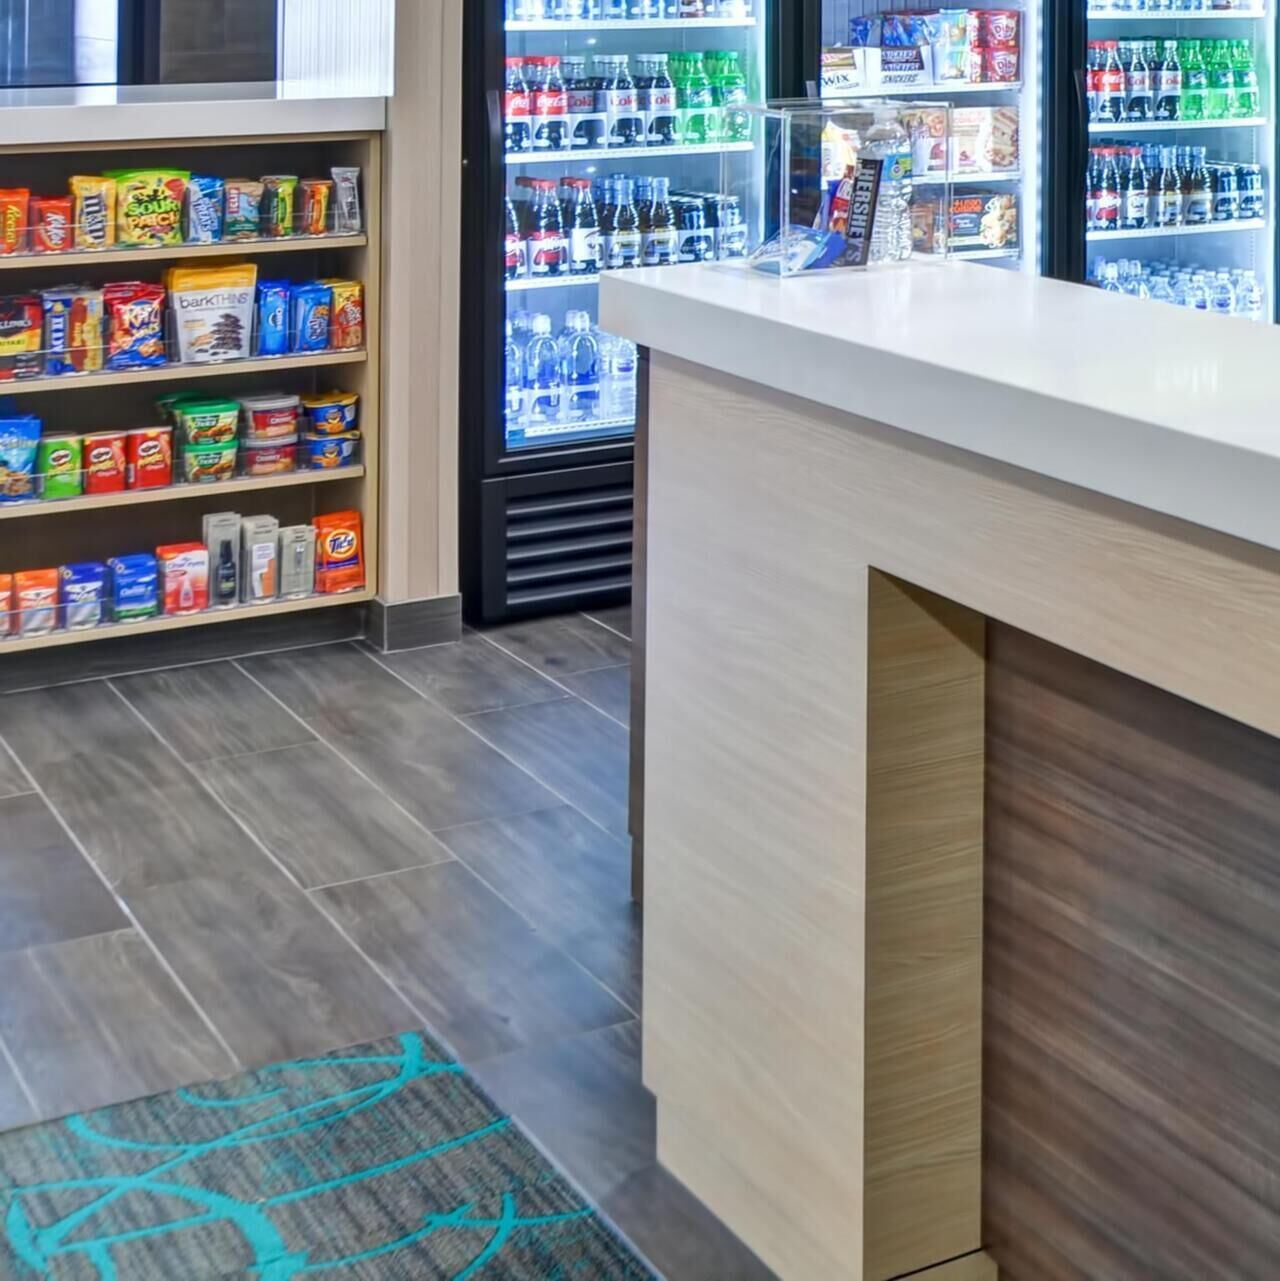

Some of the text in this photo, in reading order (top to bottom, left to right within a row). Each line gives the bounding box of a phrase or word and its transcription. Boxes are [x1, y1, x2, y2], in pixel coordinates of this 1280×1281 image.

[128, 200, 178, 216] SOUR
[846, 165, 875, 264] HERSHEY'S
[128, 212, 177, 226] PATCH
[179, 292, 249, 309] barkTHINS
